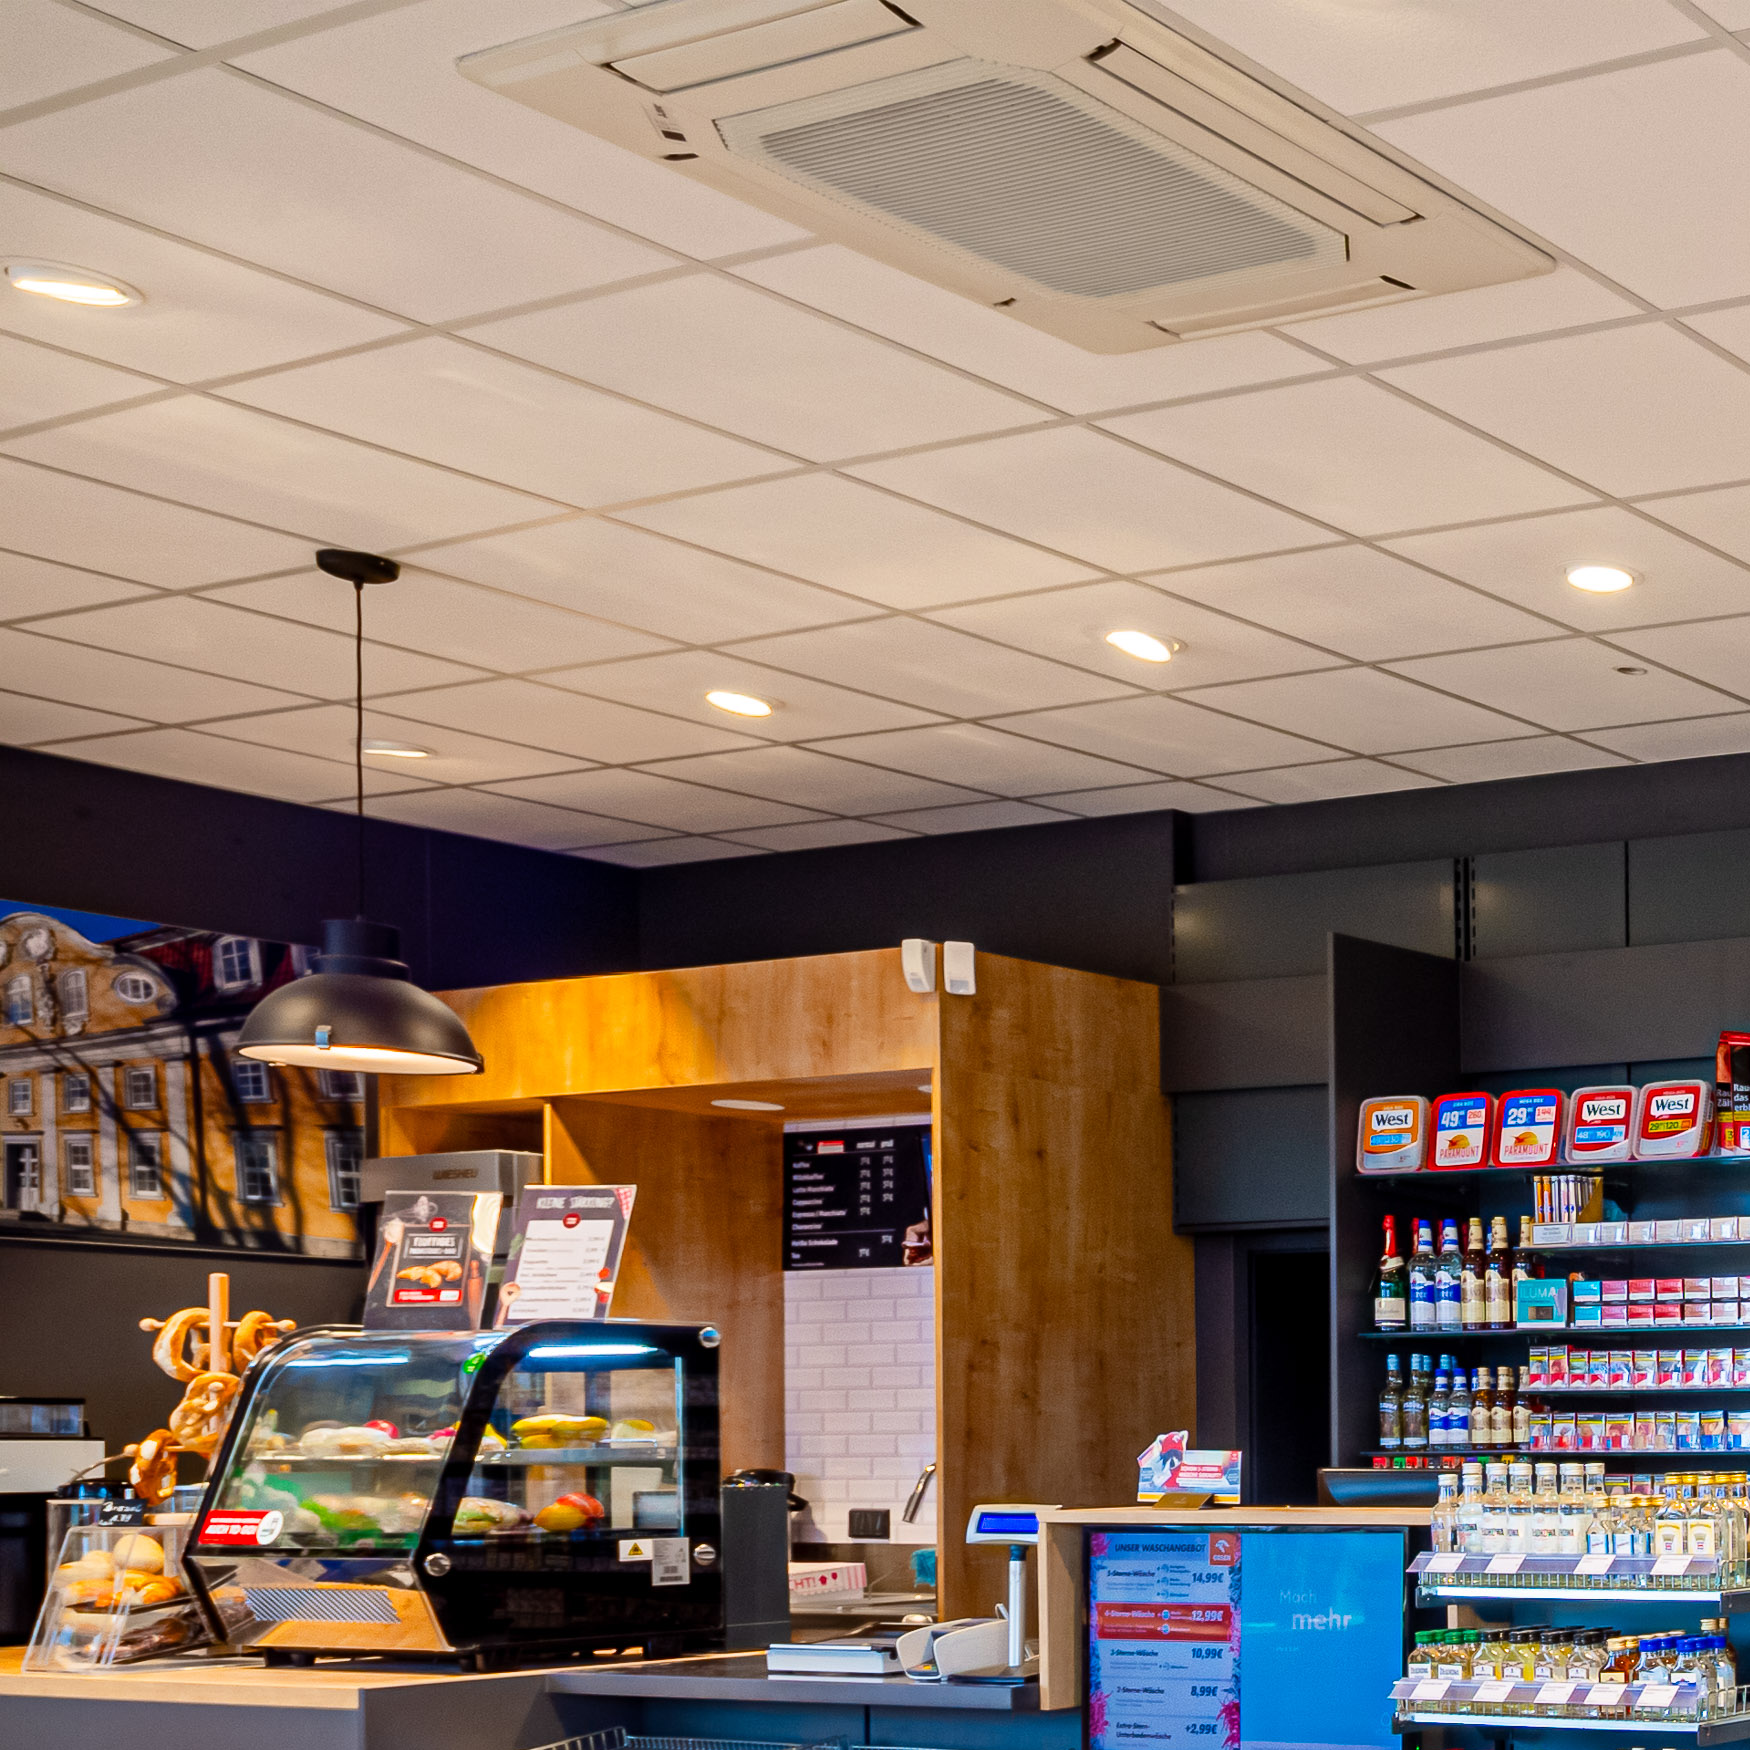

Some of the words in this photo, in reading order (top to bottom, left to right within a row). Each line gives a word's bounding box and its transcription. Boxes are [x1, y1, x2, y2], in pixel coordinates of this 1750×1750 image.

[1586, 1102, 1622, 1116] West
[1655, 1096, 1689, 1110] West
[1375, 1113, 1408, 1127] West
[1439, 1146, 1479, 1159] PARAMOUNT
[1504, 1144, 1548, 1156] PARAMOUNT
[1115, 1544, 1140, 1553] UNSER
[1142, 1544, 1206, 1553] WASCHANGEBOT
[1192, 1573, 1224, 1583] 14,99€
[1279, 1588, 1317, 1604] Mach
[1292, 1609, 1352, 1631] mehr
[1191, 1648, 1223, 1659] 10,99€
[1191, 1686, 1218, 1696] 8,99€
[1185, 1724, 1217, 1735] +2,99€
